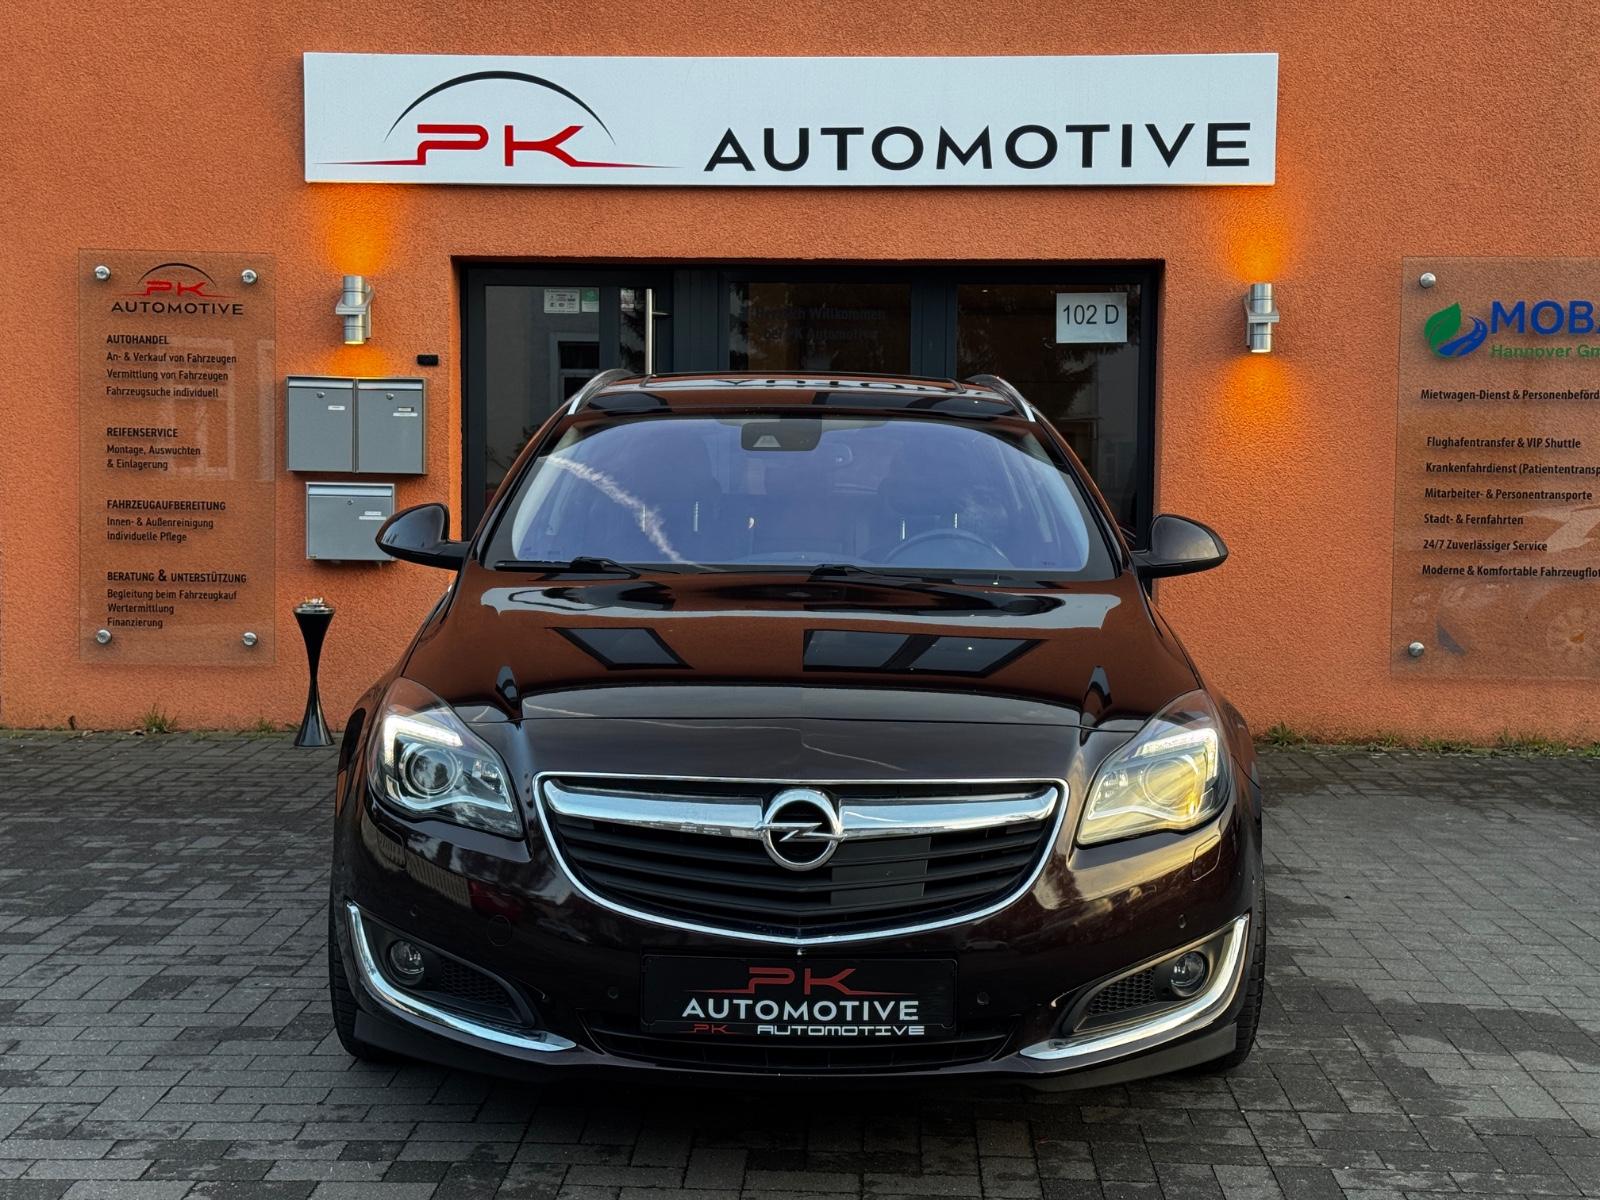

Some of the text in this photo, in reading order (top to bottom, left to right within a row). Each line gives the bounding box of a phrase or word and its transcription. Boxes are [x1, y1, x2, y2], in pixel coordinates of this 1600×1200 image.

[417, 122, 1251, 172] PK AUTOMOTIVE
[146, 280, 207, 296] PK
[111, 302, 244, 315] AUTOMOTIVE
[1063, 305, 1119, 325] 102 D
[1490, 300, 1600, 335] MOB
[106, 335, 169, 345] AUTOHANDEL
[1490, 344, 1572, 358] Hannover
[106, 353, 236, 364] An- & Verkauf von Fahrzeugen
[106, 369, 158, 381] Vermittlung
[179, 370, 228, 382] Fahrzeugen
[106, 386, 218, 398] Fahrzeugsuche individuell
[1421, 389, 1510, 401] Mietwagen-Dienst
[1512, 390, 1520, 399] &
[106, 428, 178, 437] REIFENSERVICE
[1427, 436, 1581, 449] Flughafentransfer & VIP Shuttle
[106, 445, 200, 456] Montage, Auswuchten
[107, 459, 168, 471] & Einlagerung
[1426, 462, 1517, 473] Krankenfahrdienst
[1424, 488, 1592, 501] Mitarbeiter- & Personentransporte
[107, 500, 226, 511] FAHRZEUGAUFBEREITUNG
[107, 517, 213, 529] Innen- & Außenreinigung
[1424, 514, 1524, 525] Stadt- & Fernfahrten
[107, 531, 187, 543] Individuelle Pflege
[1423, 539, 1548, 552] 24/7 Zuverlässiger Service
[107, 569, 247, 583] BERATUNG & UNTERSTÜTZUNG
[1422, 565, 1465, 575] Moderne
[1467, 565, 1475, 575] &
[1477, 565, 1537, 576] Komfortable
[107, 589, 237, 601] Begleitung beim Fahrzeugkauf
[107, 604, 174, 614] Wertermittlung
[107, 618, 163, 628] Finanzierung
[749, 967, 856, 995] PK
[682, 998, 919, 1020] AUTOMOTIVE
[693, 1024, 728, 1033] PK
